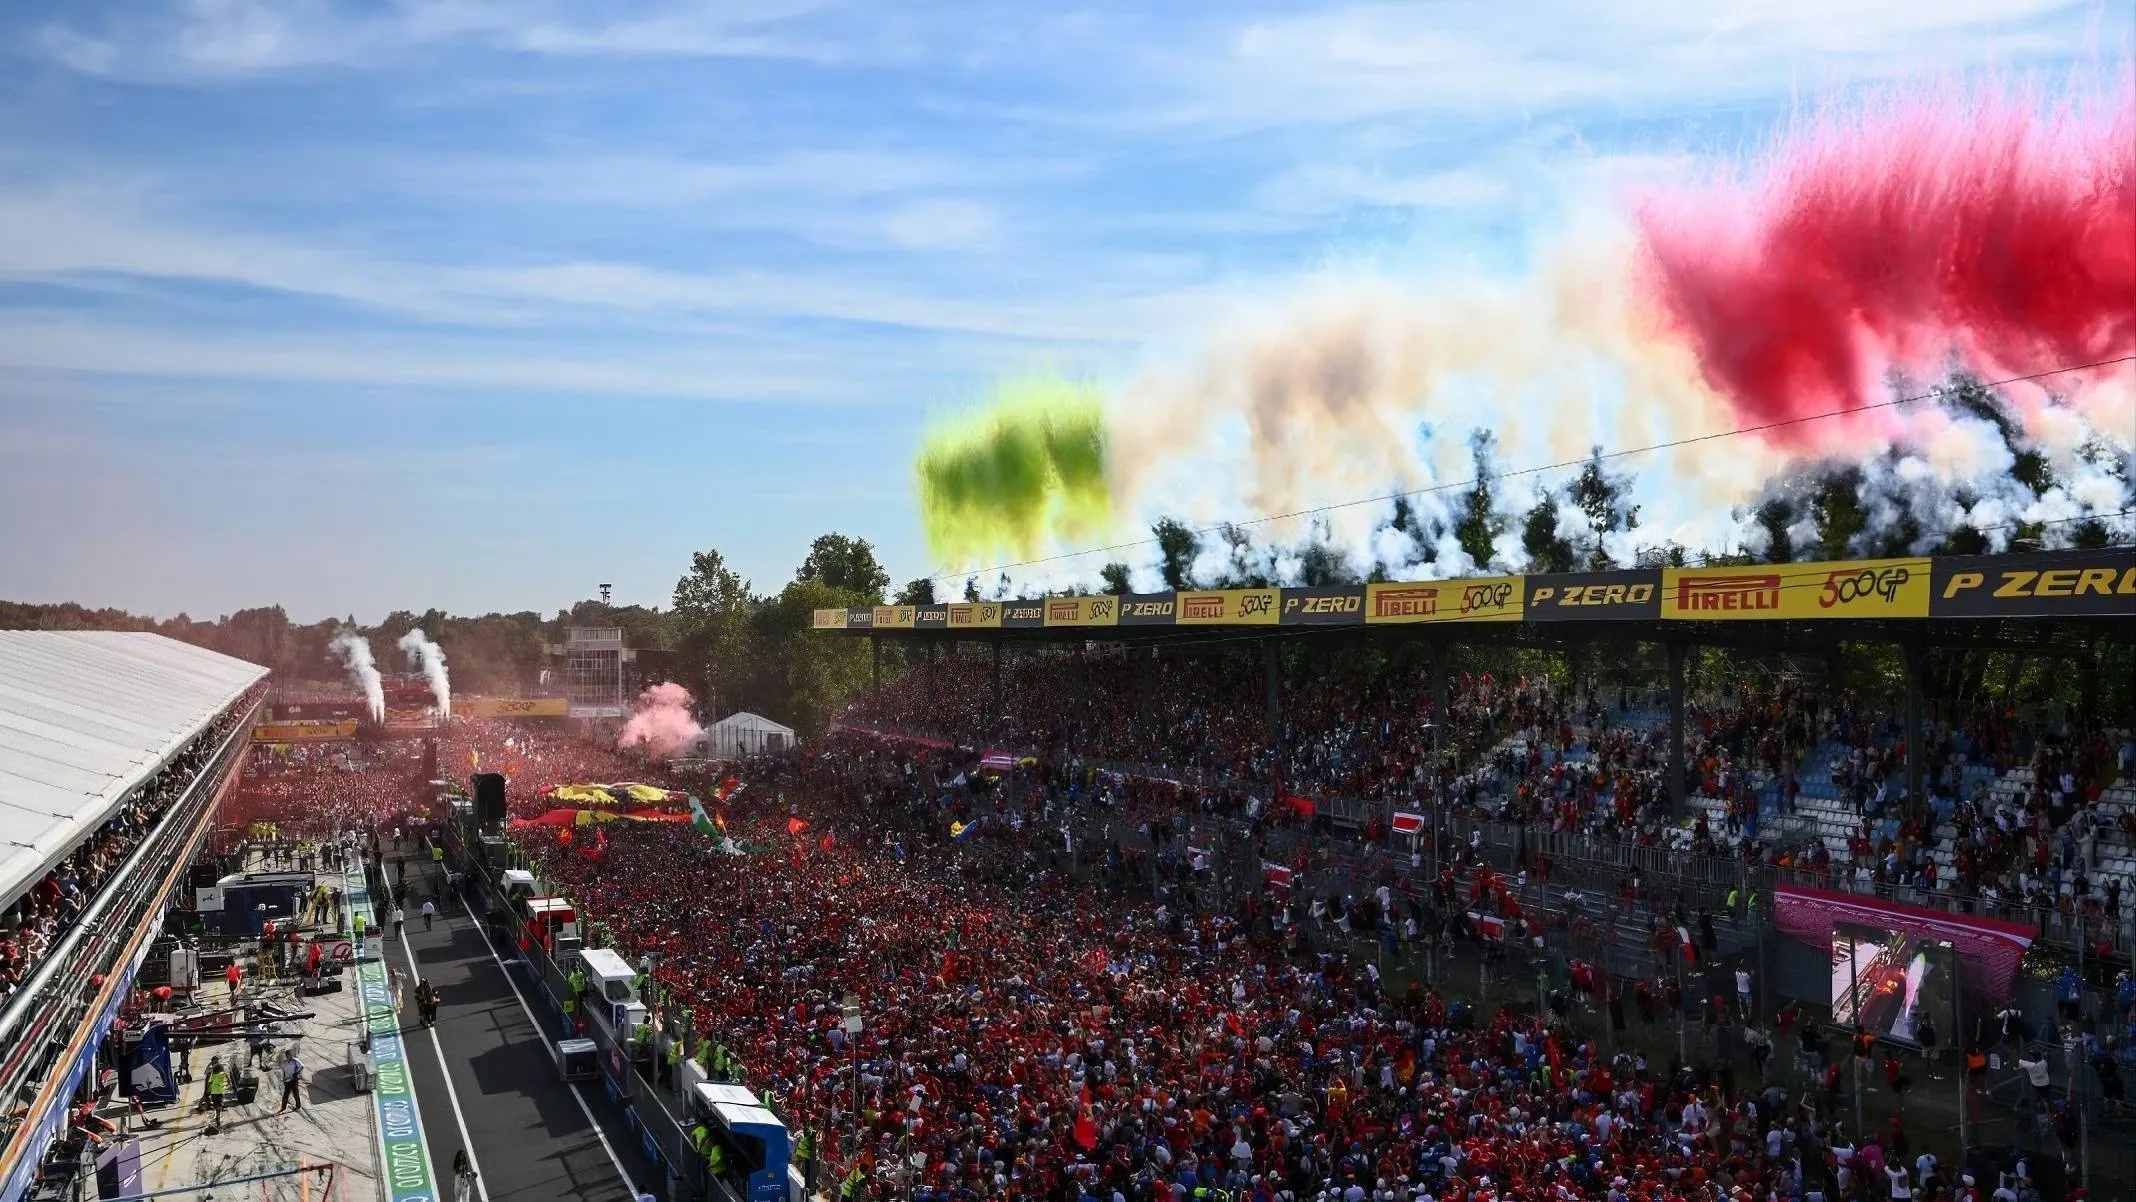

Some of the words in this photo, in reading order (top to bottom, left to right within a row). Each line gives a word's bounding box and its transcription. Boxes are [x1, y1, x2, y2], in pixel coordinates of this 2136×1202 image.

[1530, 588, 1554, 607] P
[1558, 584, 1655, 606] ZERO
[1677, 574, 1781, 610] PIRELLI
[1818, 568, 1909, 608] 500GP
[1943, 573, 1984, 599] P
[1121, 603, 1131, 616] P
[1133, 602, 1174, 616] ZERO
[1284, 598, 1299, 614] P
[1301, 596, 1361, 613] ZERO
[1375, 588, 1439, 617] PIRELLI
